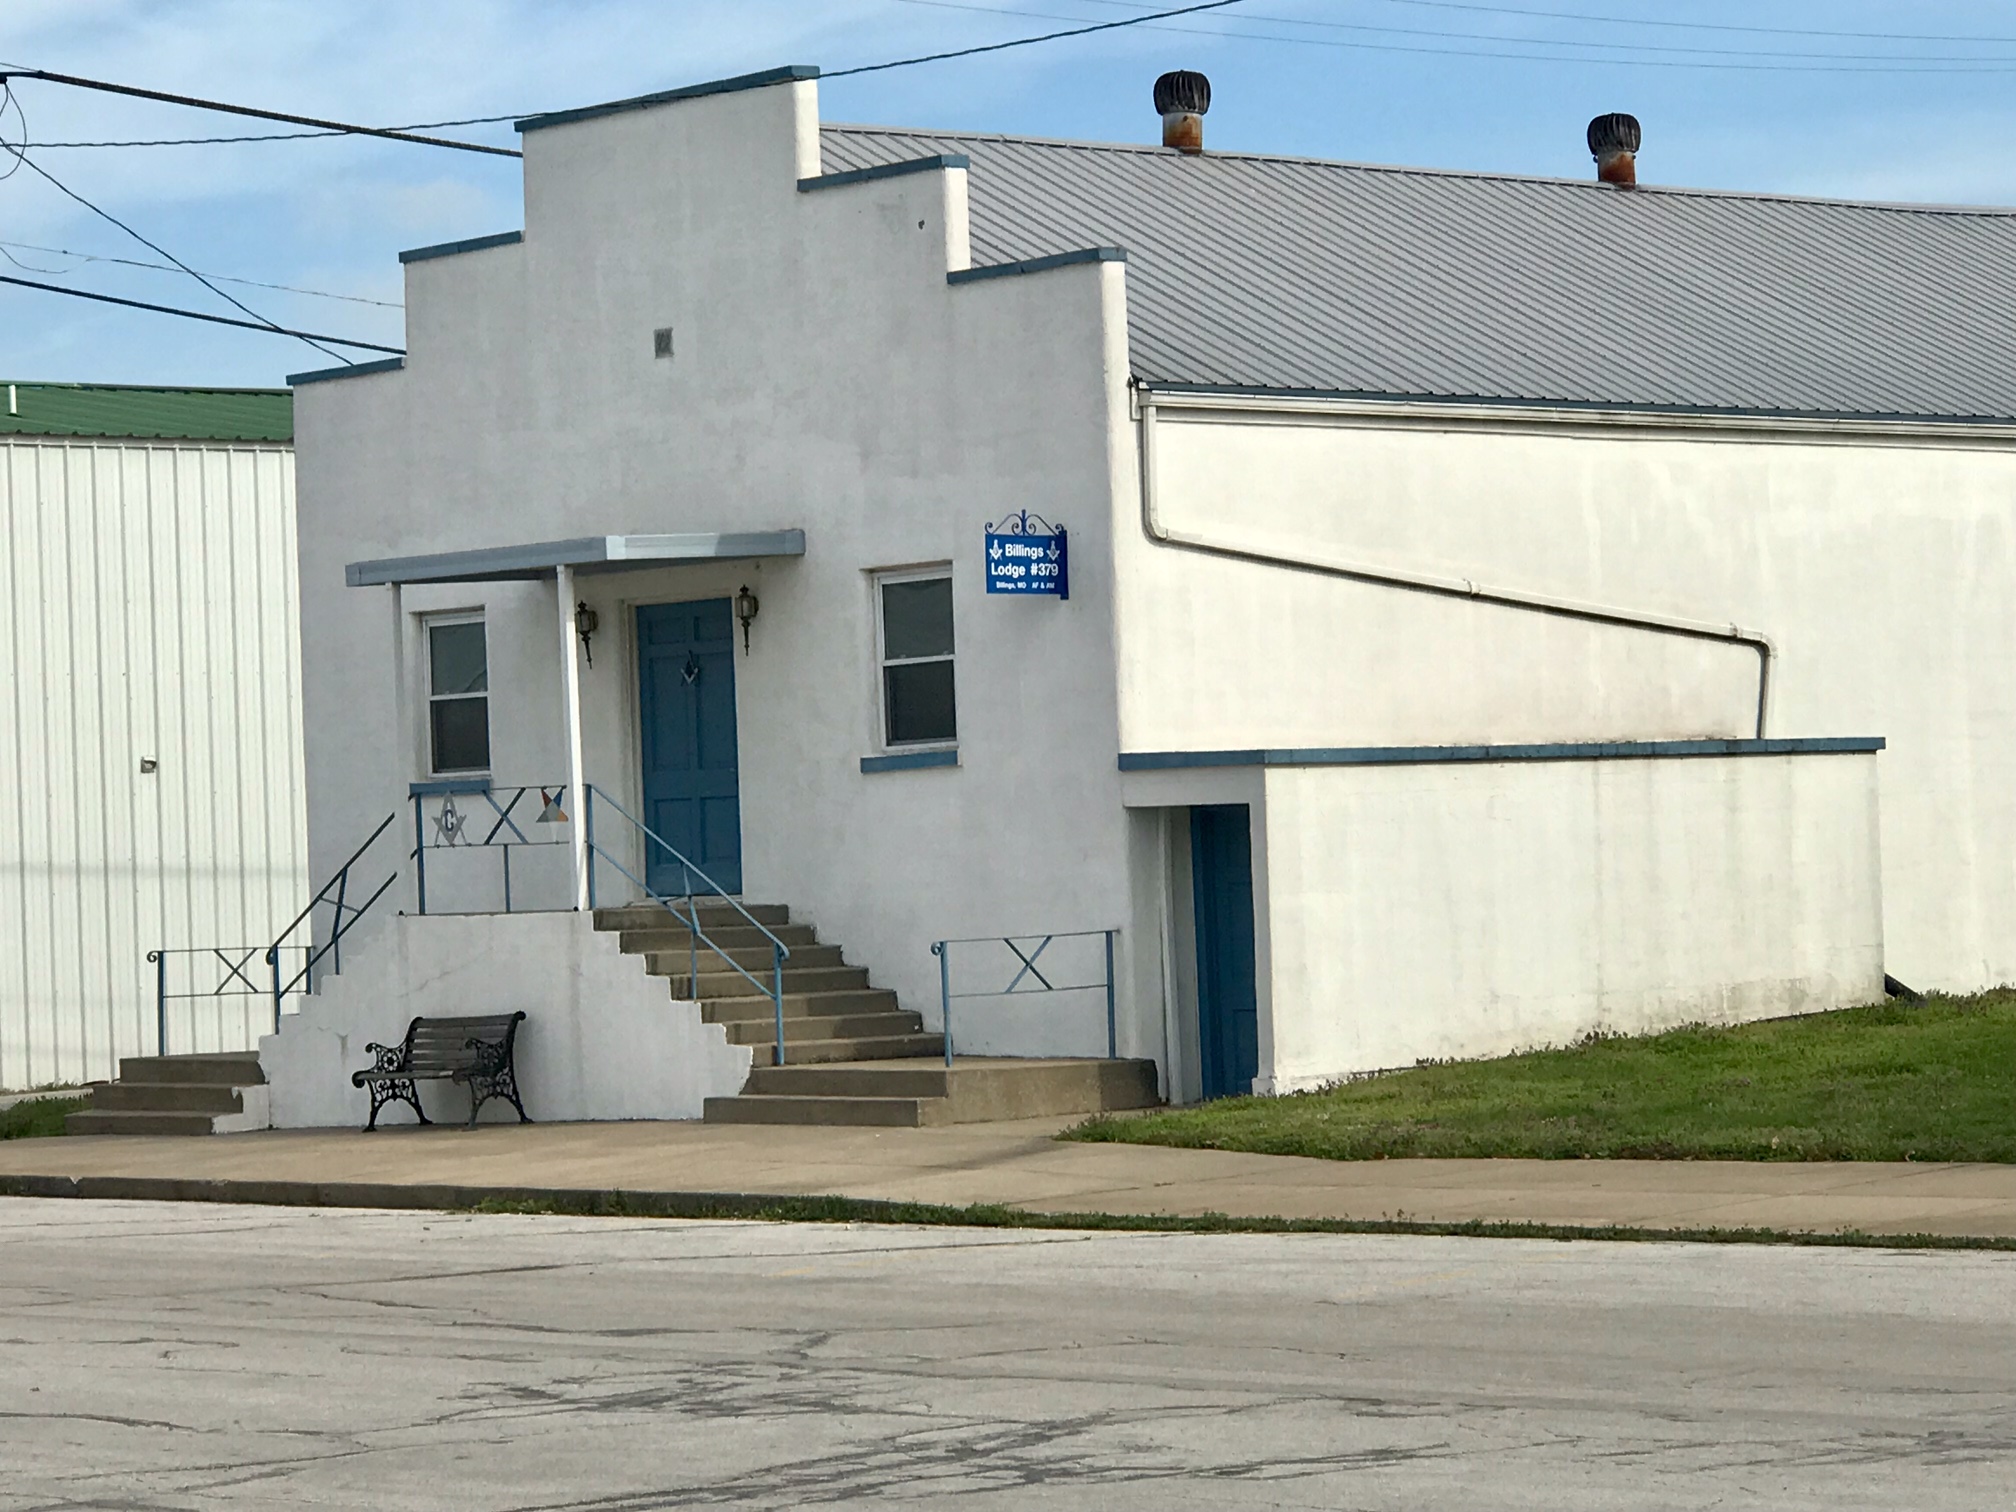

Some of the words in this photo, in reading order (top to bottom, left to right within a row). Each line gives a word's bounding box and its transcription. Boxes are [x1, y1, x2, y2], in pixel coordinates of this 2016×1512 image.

[1005, 543, 1044, 560] Billings
[991, 562, 1026, 578] Lodge
[1030, 562, 1059, 576] #379
